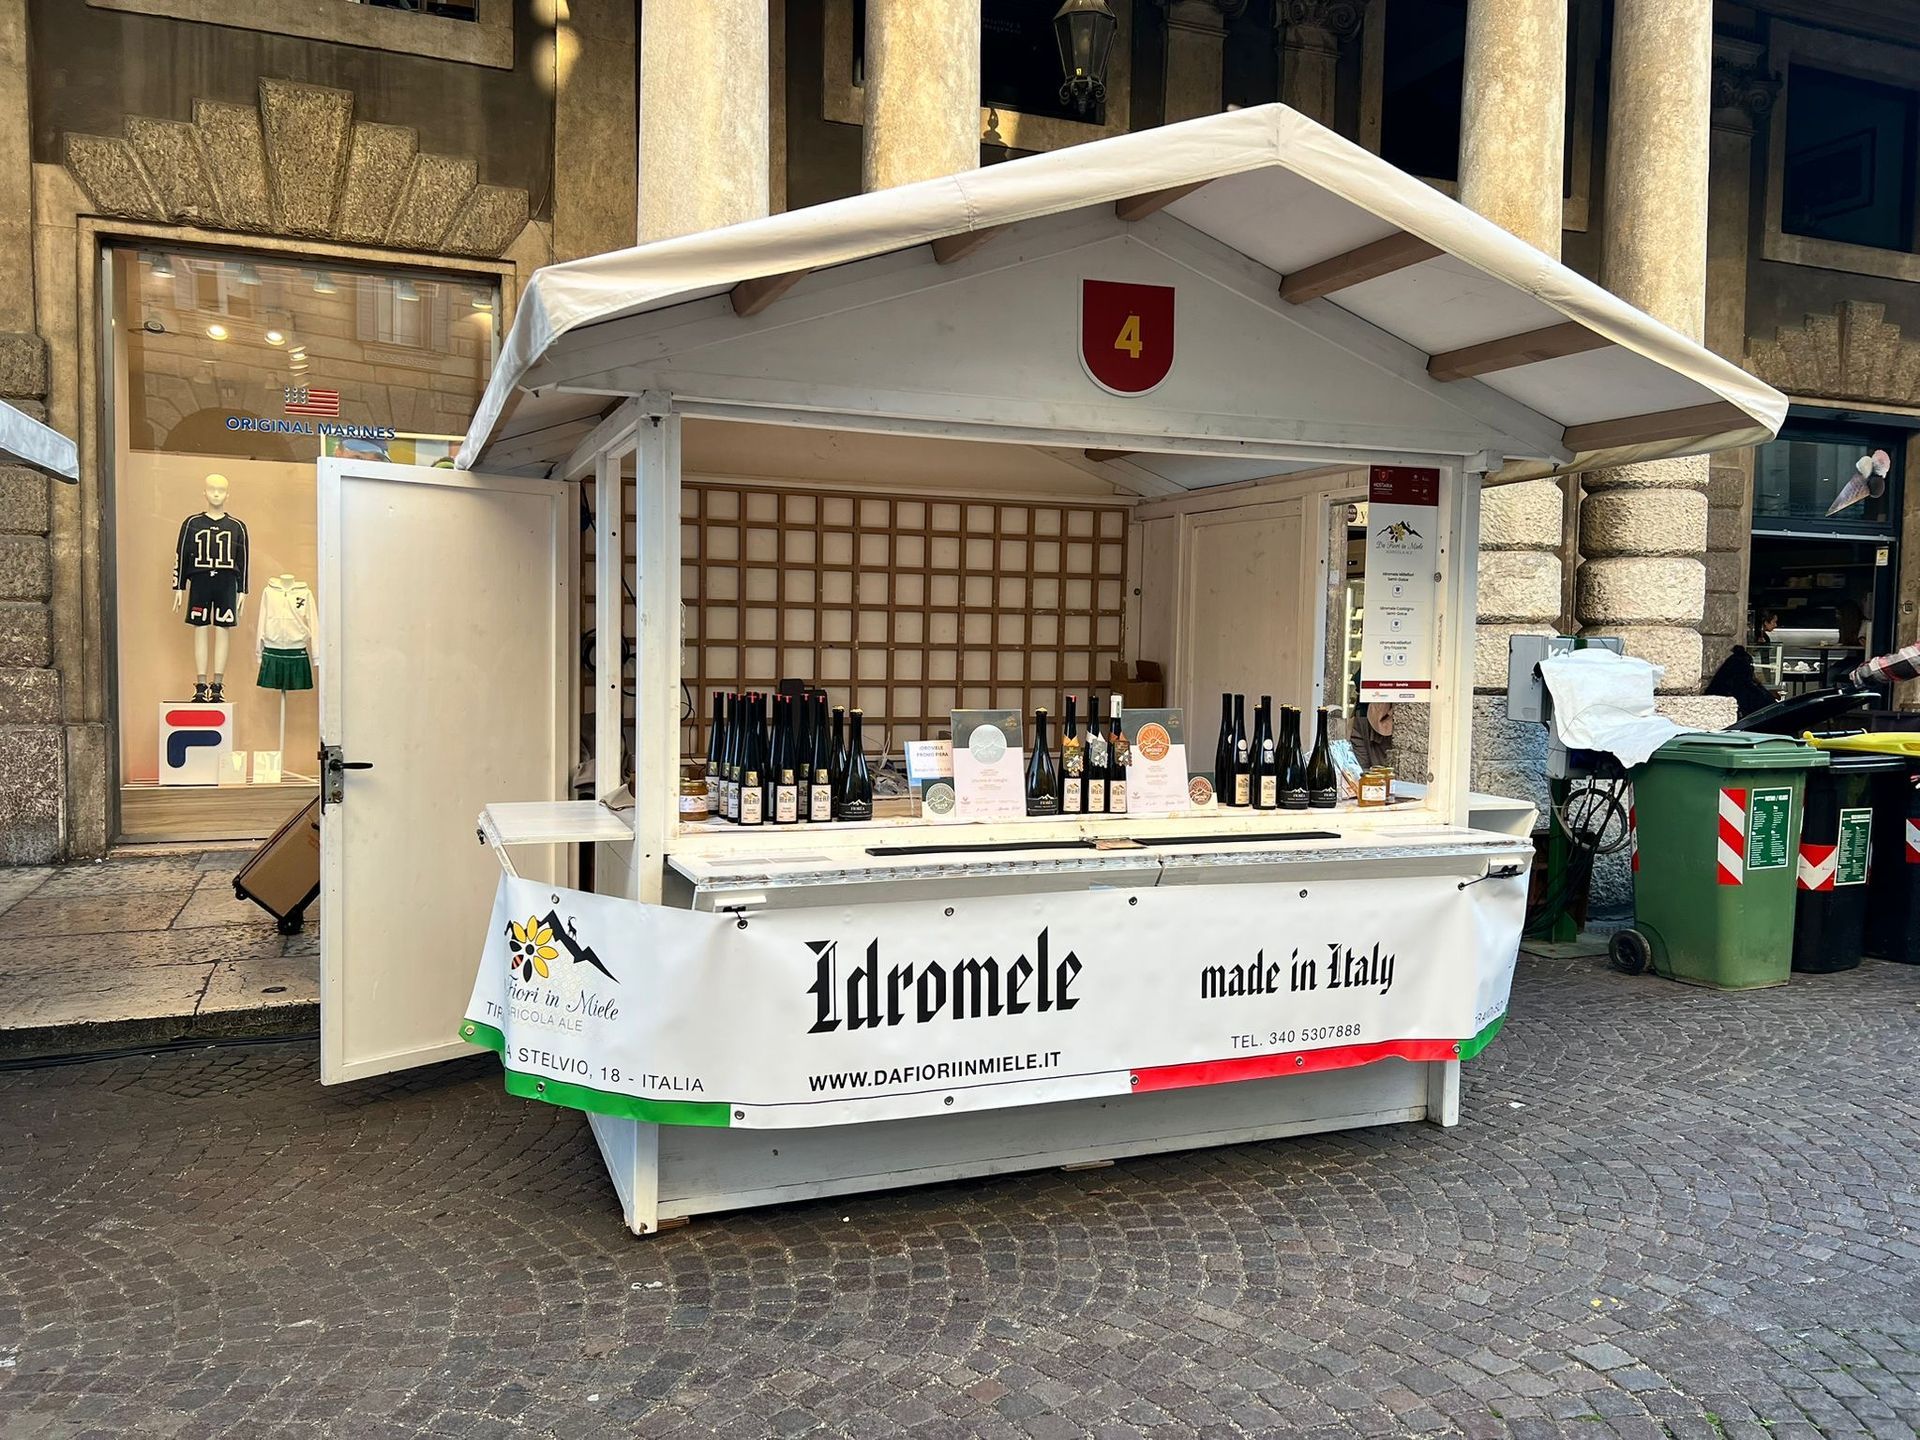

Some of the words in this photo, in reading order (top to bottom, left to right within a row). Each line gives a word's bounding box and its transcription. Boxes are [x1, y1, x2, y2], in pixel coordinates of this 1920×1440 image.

[1114, 315, 1143, 358] 4
[226, 416, 313, 434] ORIGINAL
[317, 422, 396, 440] MARINES
[194, 529, 234, 568] 11
[191, 604, 235, 622] FILA
[803, 924, 1083, 1034] Idromele
[1200, 948, 1281, 999] made
[1290, 947, 1318, 993] in
[1326, 941, 1396, 995] Italy
[545, 989, 560, 1008] in
[566, 989, 619, 1021] Miele
[558, 1016, 583, 1032] ALE
[1231, 1032, 1264, 1050] TEL.
[1269, 1027, 1296, 1046] 340
[1301, 1023, 1362, 1043] 5307888
[518, 1048, 593, 1079] STELVIO,
[600, 1066, 621, 1083] 18
[642, 1073, 705, 1093] ITALIA
[808, 1051, 1062, 1092] WWW.DAFIORIINMIELE.IT
